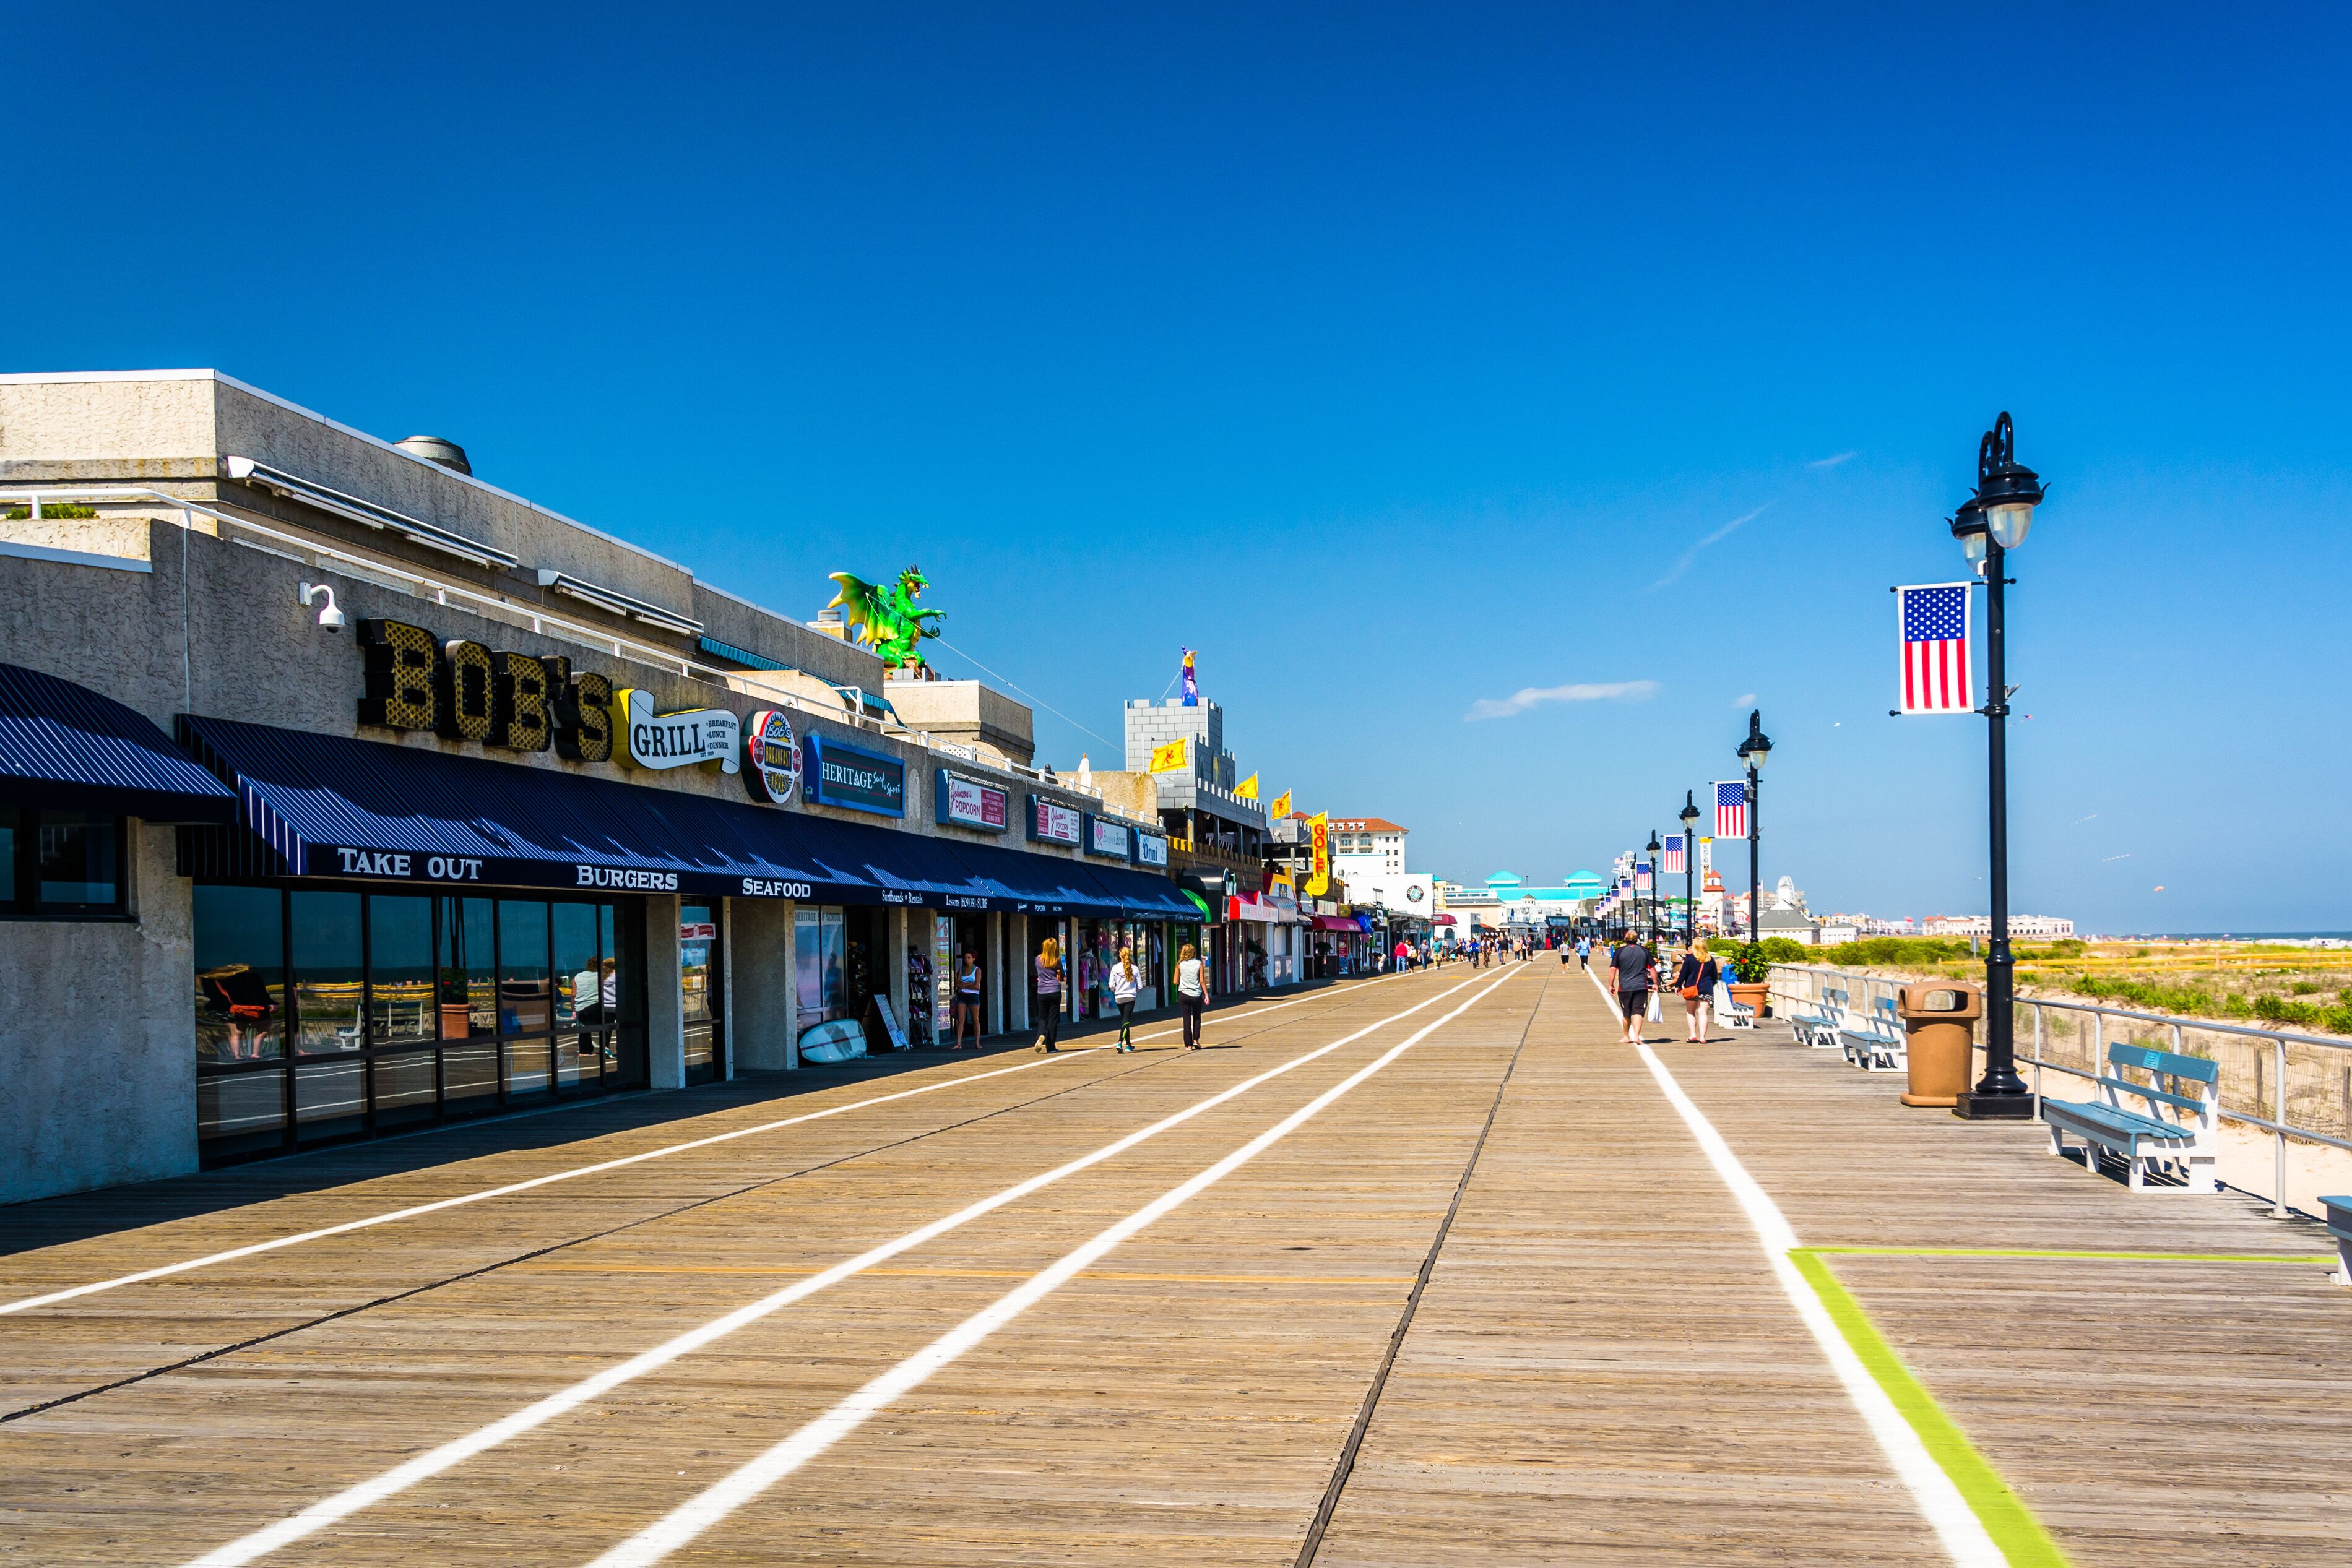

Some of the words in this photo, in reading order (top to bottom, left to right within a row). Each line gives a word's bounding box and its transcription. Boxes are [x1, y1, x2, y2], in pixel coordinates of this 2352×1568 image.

[357, 618, 613, 762] BOB'S
[708, 720, 737, 730] BREAKFAST
[767, 725, 792, 739] Bob's
[634, 723, 706, 757] GRILL
[709, 731, 726, 739] LUNCH
[709, 742, 729, 750] DINNER
[766, 745, 791, 767] BREAKFAST
[768, 771, 790, 793] EXPRESS
[822, 762, 873, 790] HERITAGE
[873, 771, 885, 788] Surf
[887, 783, 901, 797] Sport
[955, 800, 980, 817] POPCORN
[1055, 822, 1068, 831] POPCORN
[1143, 842, 1158, 861] Onni
[1313, 824, 1325, 874] GOLF
[338, 848, 411, 876] TAKE
[428, 856, 482, 879] OUT
[576, 865, 678, 890] BURGERS
[743, 877, 811, 898] SEAFOOD
[882, 889, 904, 903] Surfboards
[908, 892, 923, 903] Rentals
[946, 895, 959, 906] Lessons
[795, 911, 816, 921] HERITAGE
